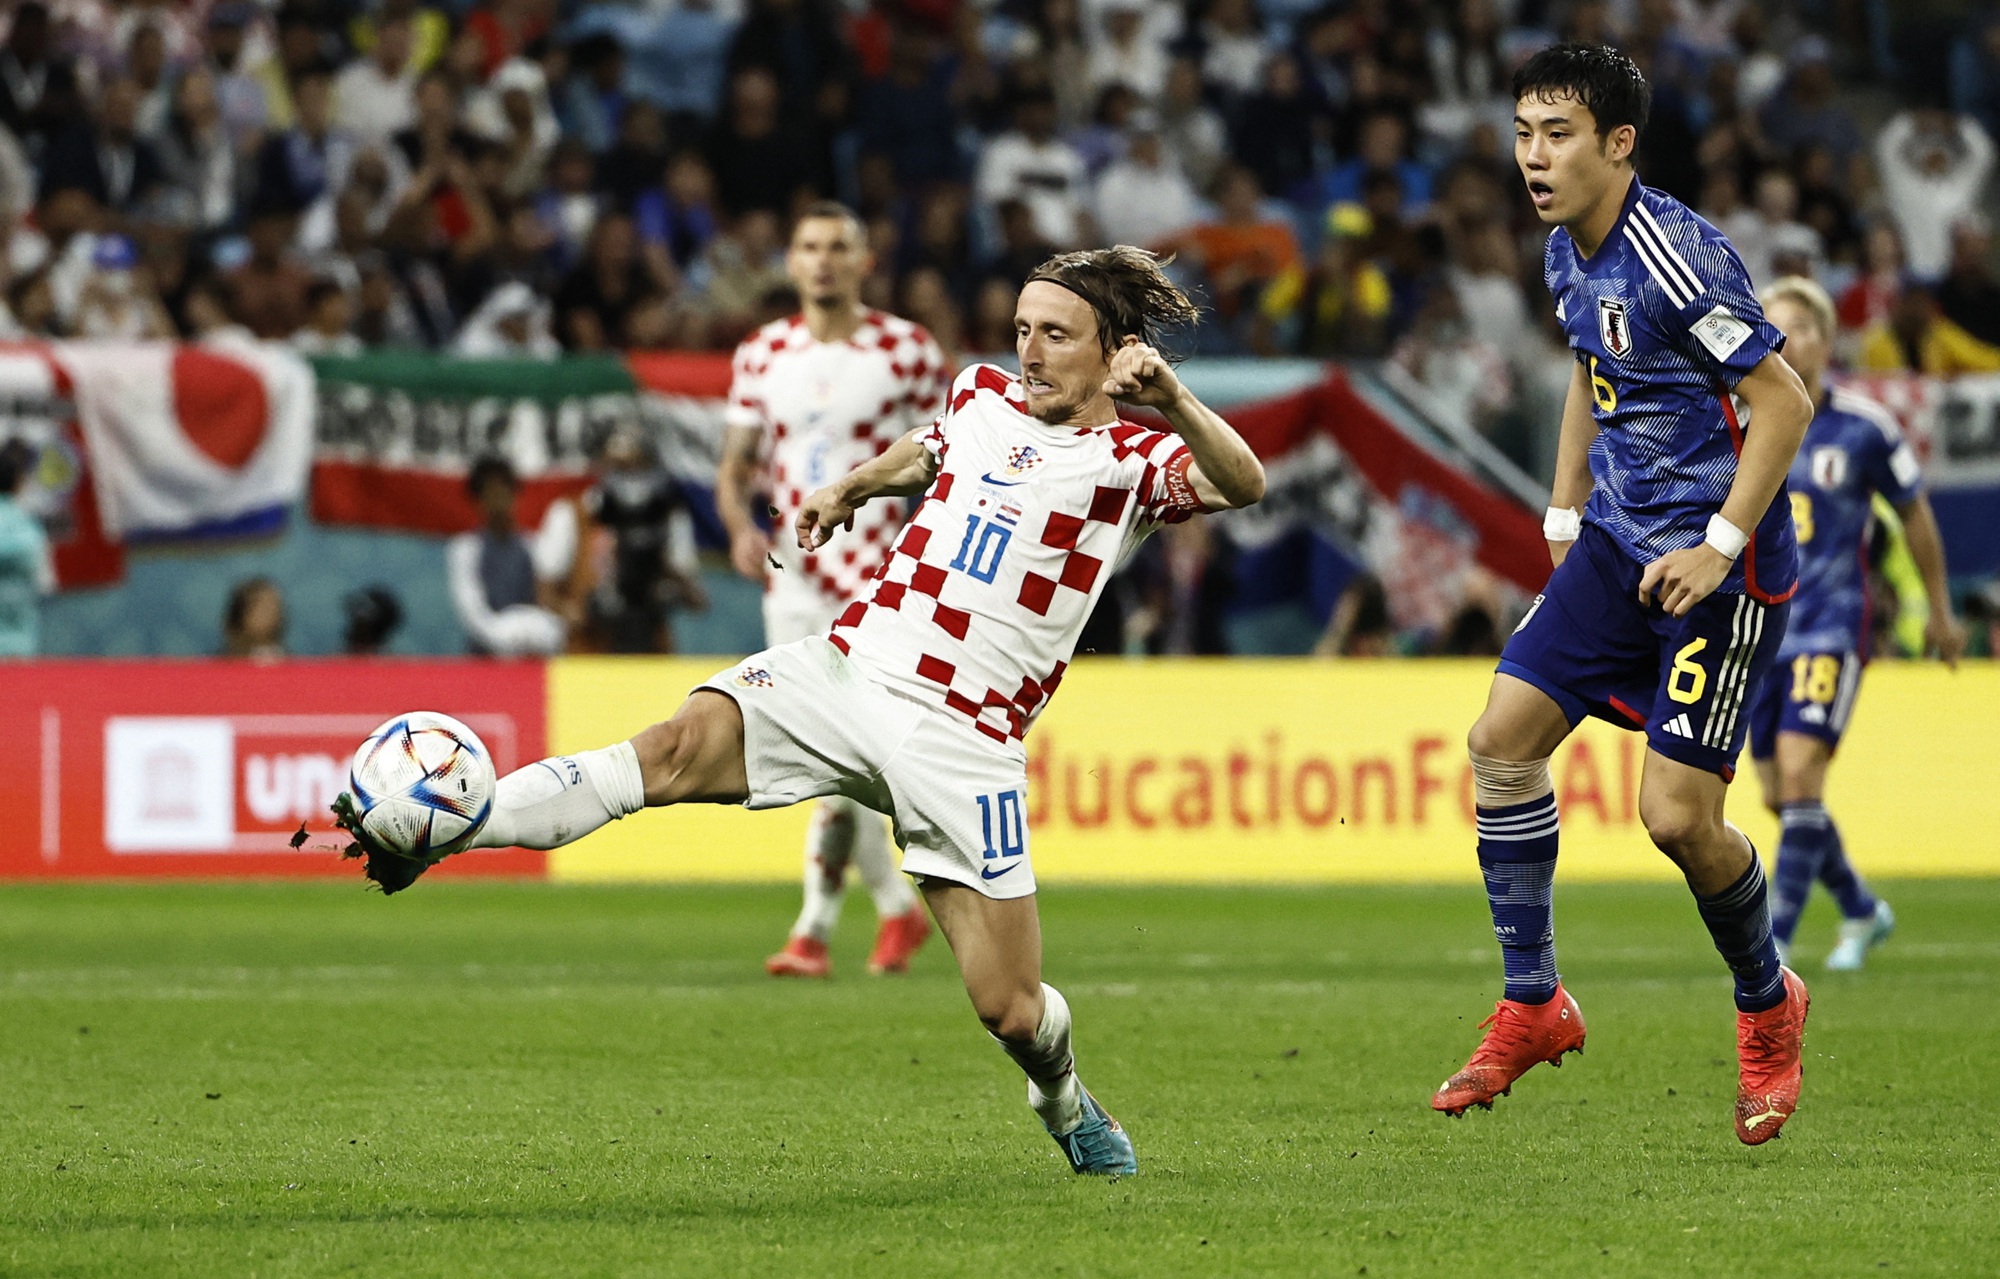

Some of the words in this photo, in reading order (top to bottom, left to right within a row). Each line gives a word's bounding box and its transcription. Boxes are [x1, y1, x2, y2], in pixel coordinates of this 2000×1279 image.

[1590, 355, 1617, 413] 6
[949, 513, 1012, 585] 10
[1667, 637, 1708, 705] 6
[1789, 653, 1841, 705] 18
[976, 790, 1023, 859] 10
[1494, 926, 1517, 934] AN
